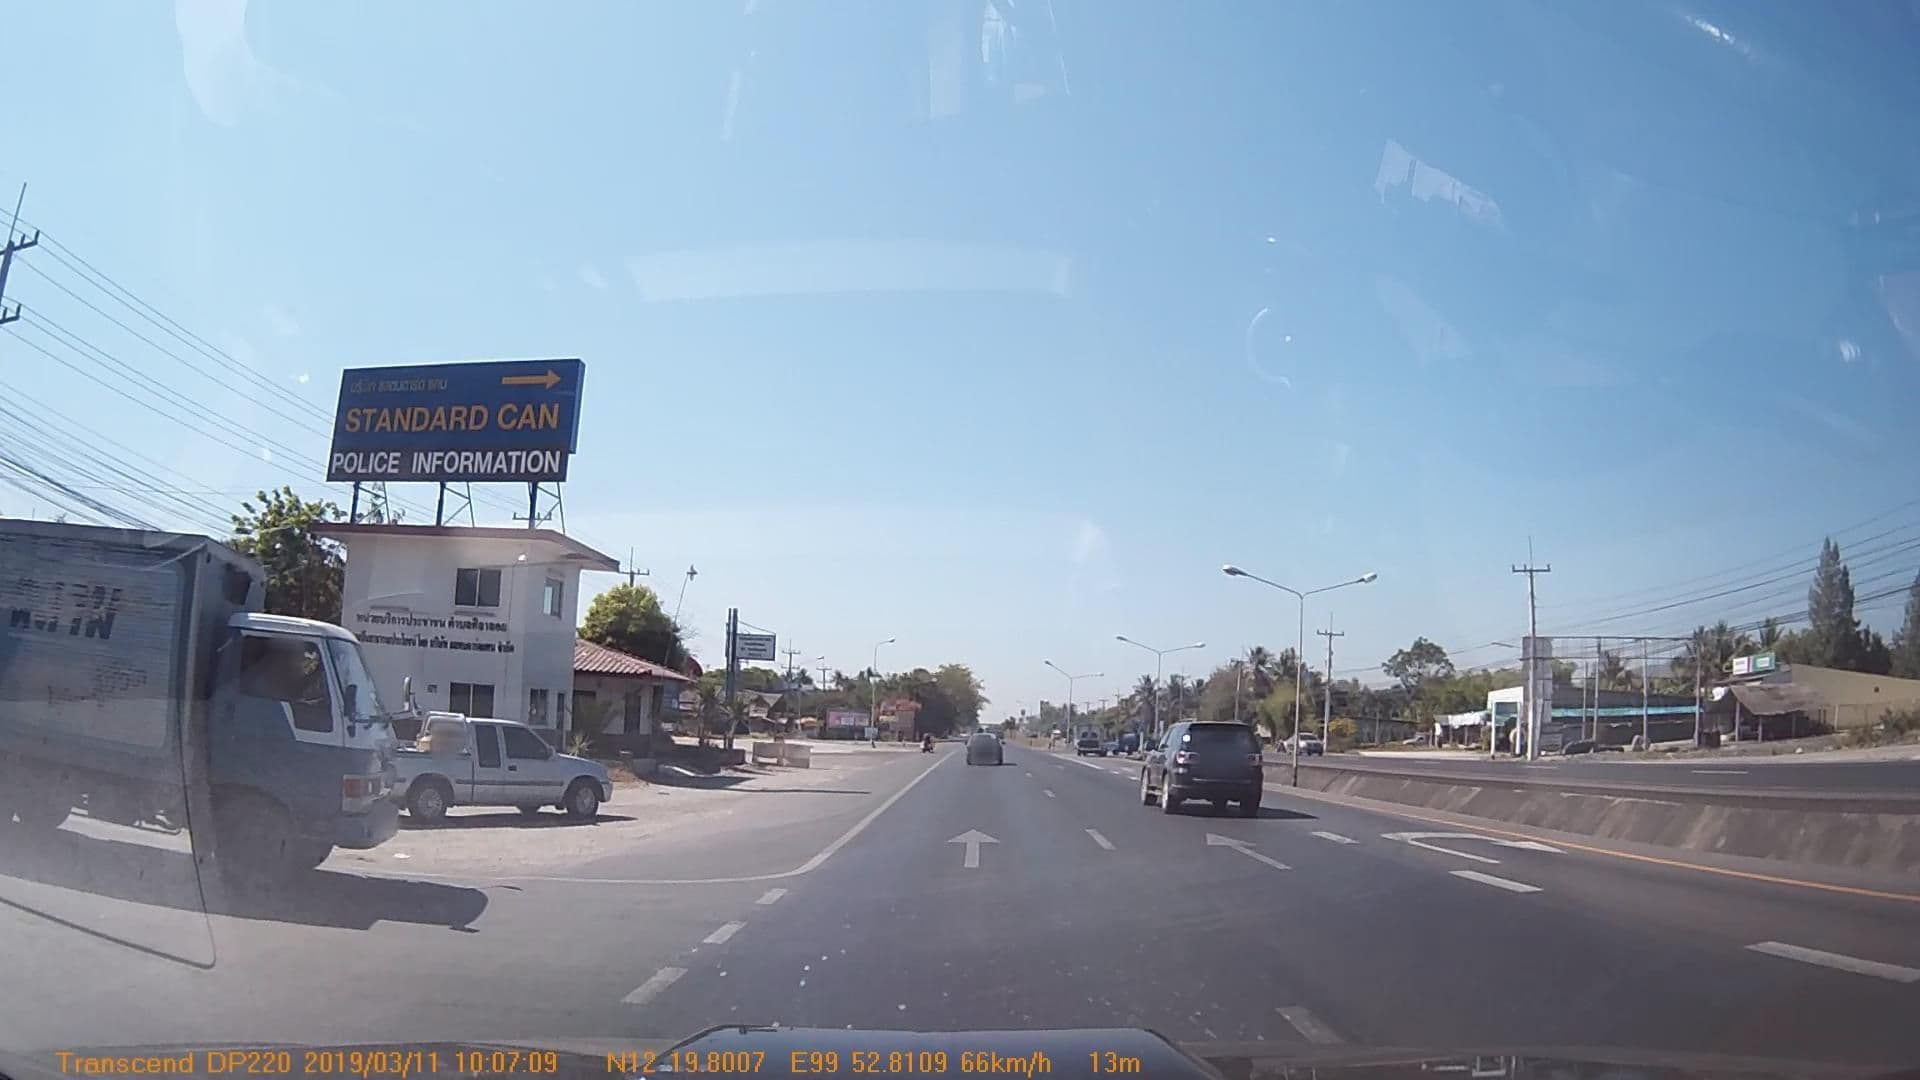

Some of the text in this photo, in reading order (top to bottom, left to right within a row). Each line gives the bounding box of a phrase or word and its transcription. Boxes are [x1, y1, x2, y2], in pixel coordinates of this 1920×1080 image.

[345, 403, 559, 432] STANDARD CAN
[331, 450, 561, 474] POLICE INFORMATION
